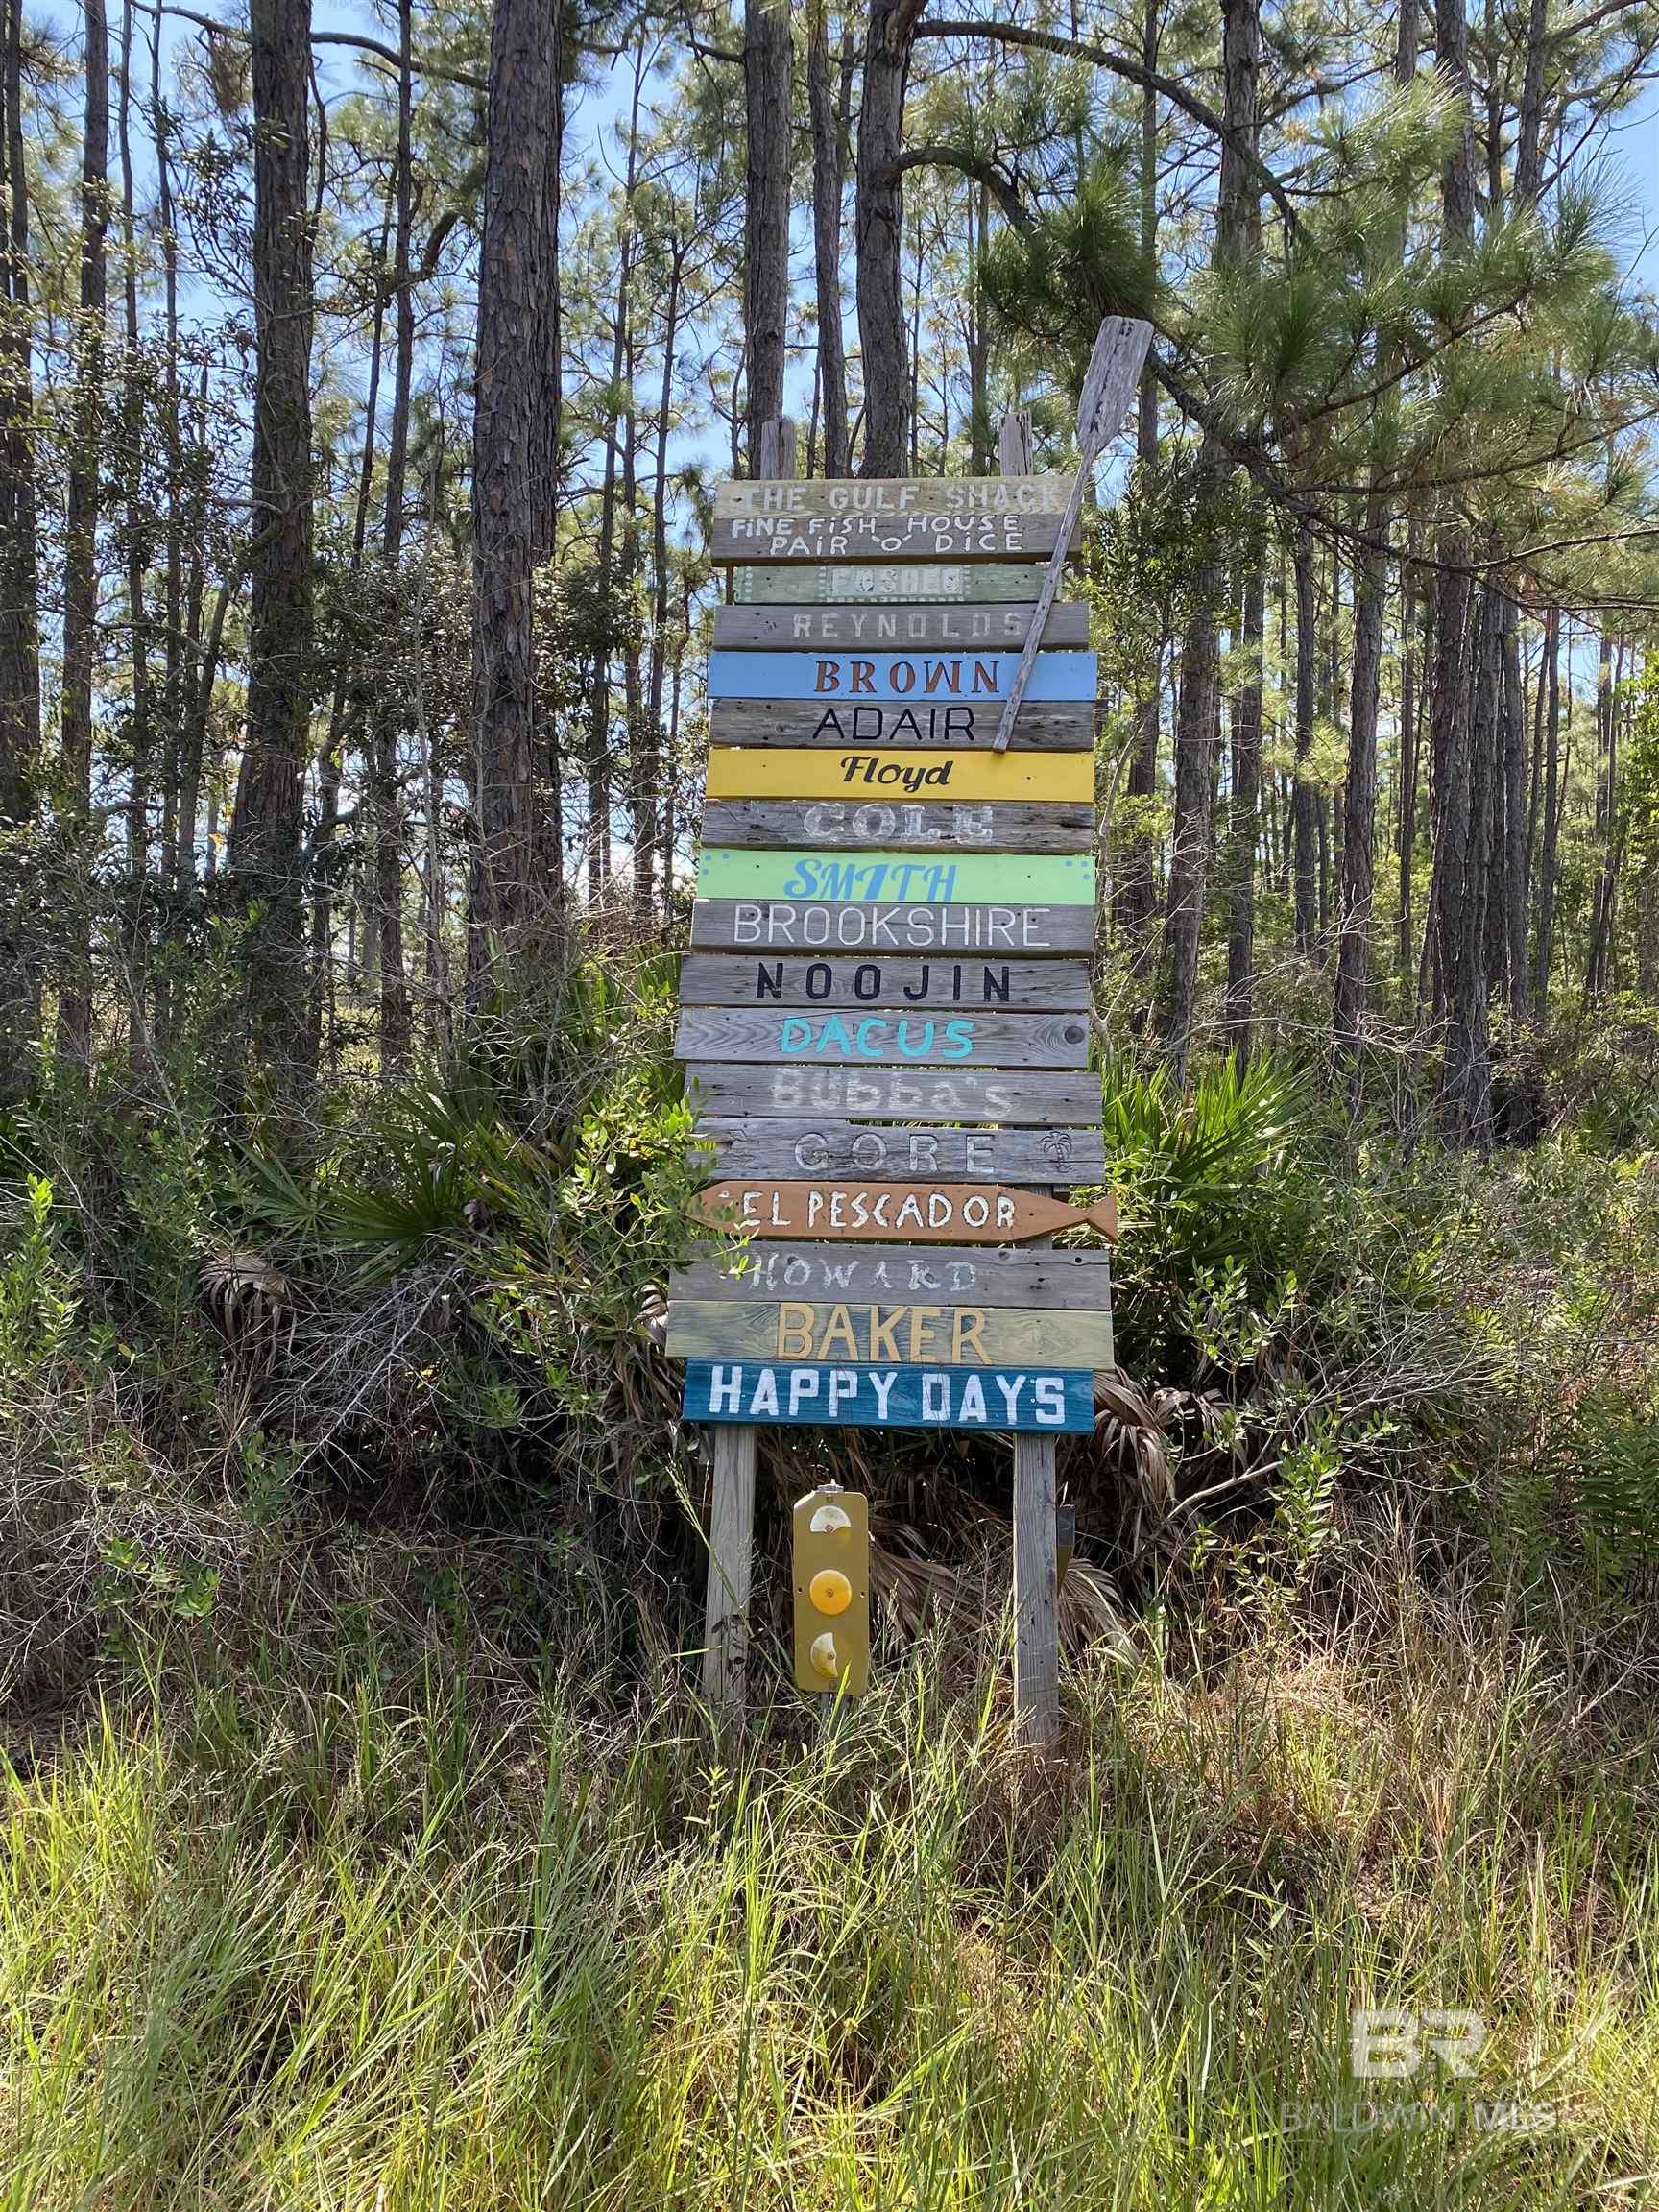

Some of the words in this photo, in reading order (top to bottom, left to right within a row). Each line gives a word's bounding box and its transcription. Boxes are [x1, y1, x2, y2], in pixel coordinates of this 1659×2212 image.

[744, 487, 806, 511] THE
[829, 486, 921, 510] GULF
[945, 484, 1061, 510] SHACK
[907, 514, 1020, 534] HOUSE
[793, 613, 1023, 638] REYNOLDS
[813, 661, 1000, 694] BROWN
[812, 707, 976, 741] ADAIR
[840, 756, 954, 793] Floyd
[803, 803, 995, 846] COLE
[782, 858, 958, 902] SMITH
[733, 904, 1052, 948] BROOKSHIRE
[757, 962, 1011, 1002] NOOJIN
[781, 1016, 976, 1058] DACUS
[794, 1133, 997, 1174] GORE
[742, 1190, 792, 1227] EL
[807, 1190, 1016, 1230] PESCADOR
[777, 1302, 995, 1365] BAKER
[709, 1365, 899, 1420] HAPPY
[921, 1373, 1067, 1426] DAYS
